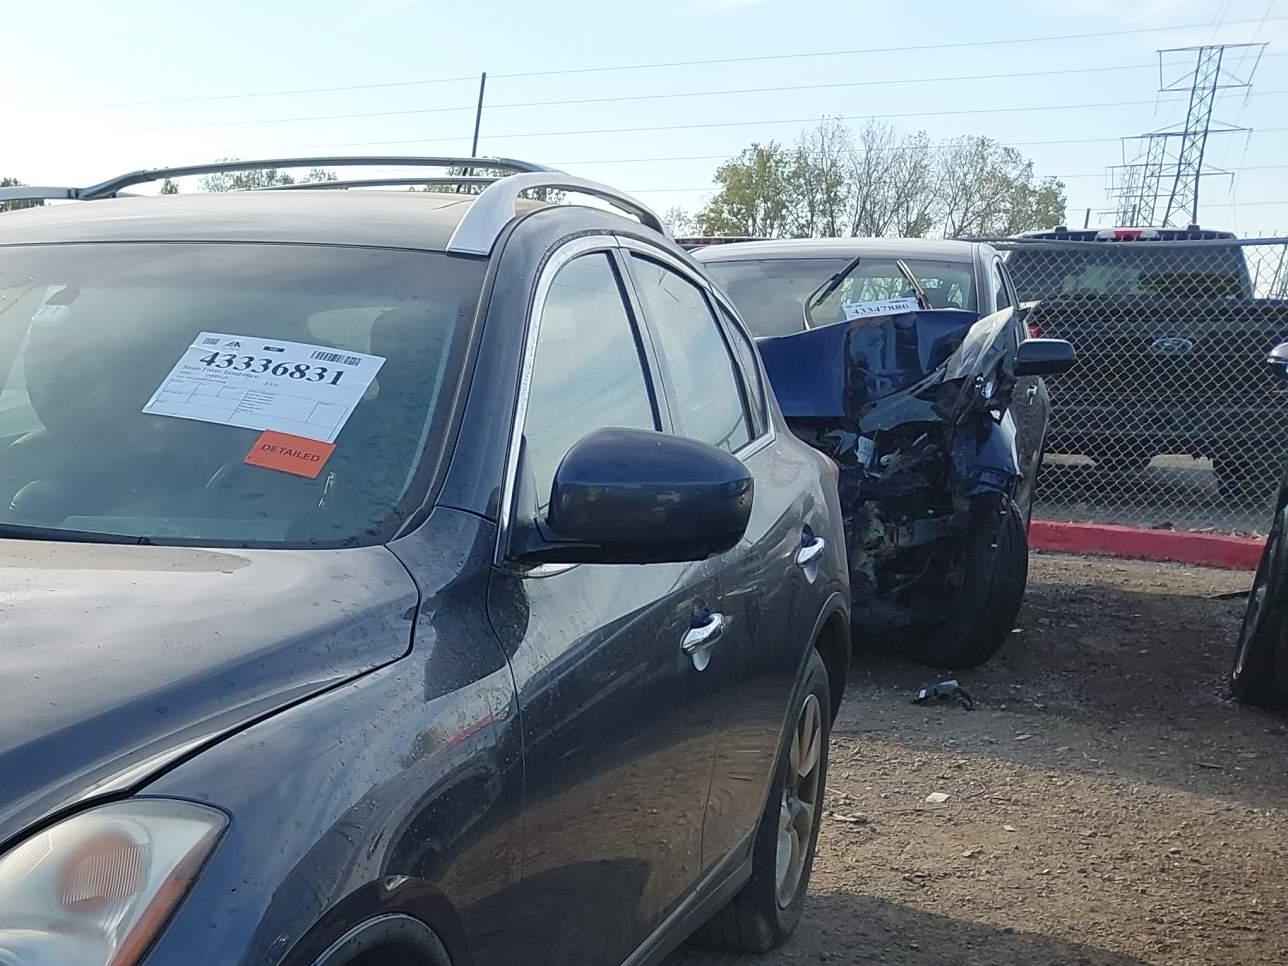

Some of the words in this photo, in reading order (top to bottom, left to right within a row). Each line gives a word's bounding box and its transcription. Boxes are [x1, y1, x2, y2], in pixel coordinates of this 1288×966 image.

[199, 351, 345, 386] 43336831
[224, 369, 260, 379] Insurance
[261, 443, 320, 463] DETAILED
